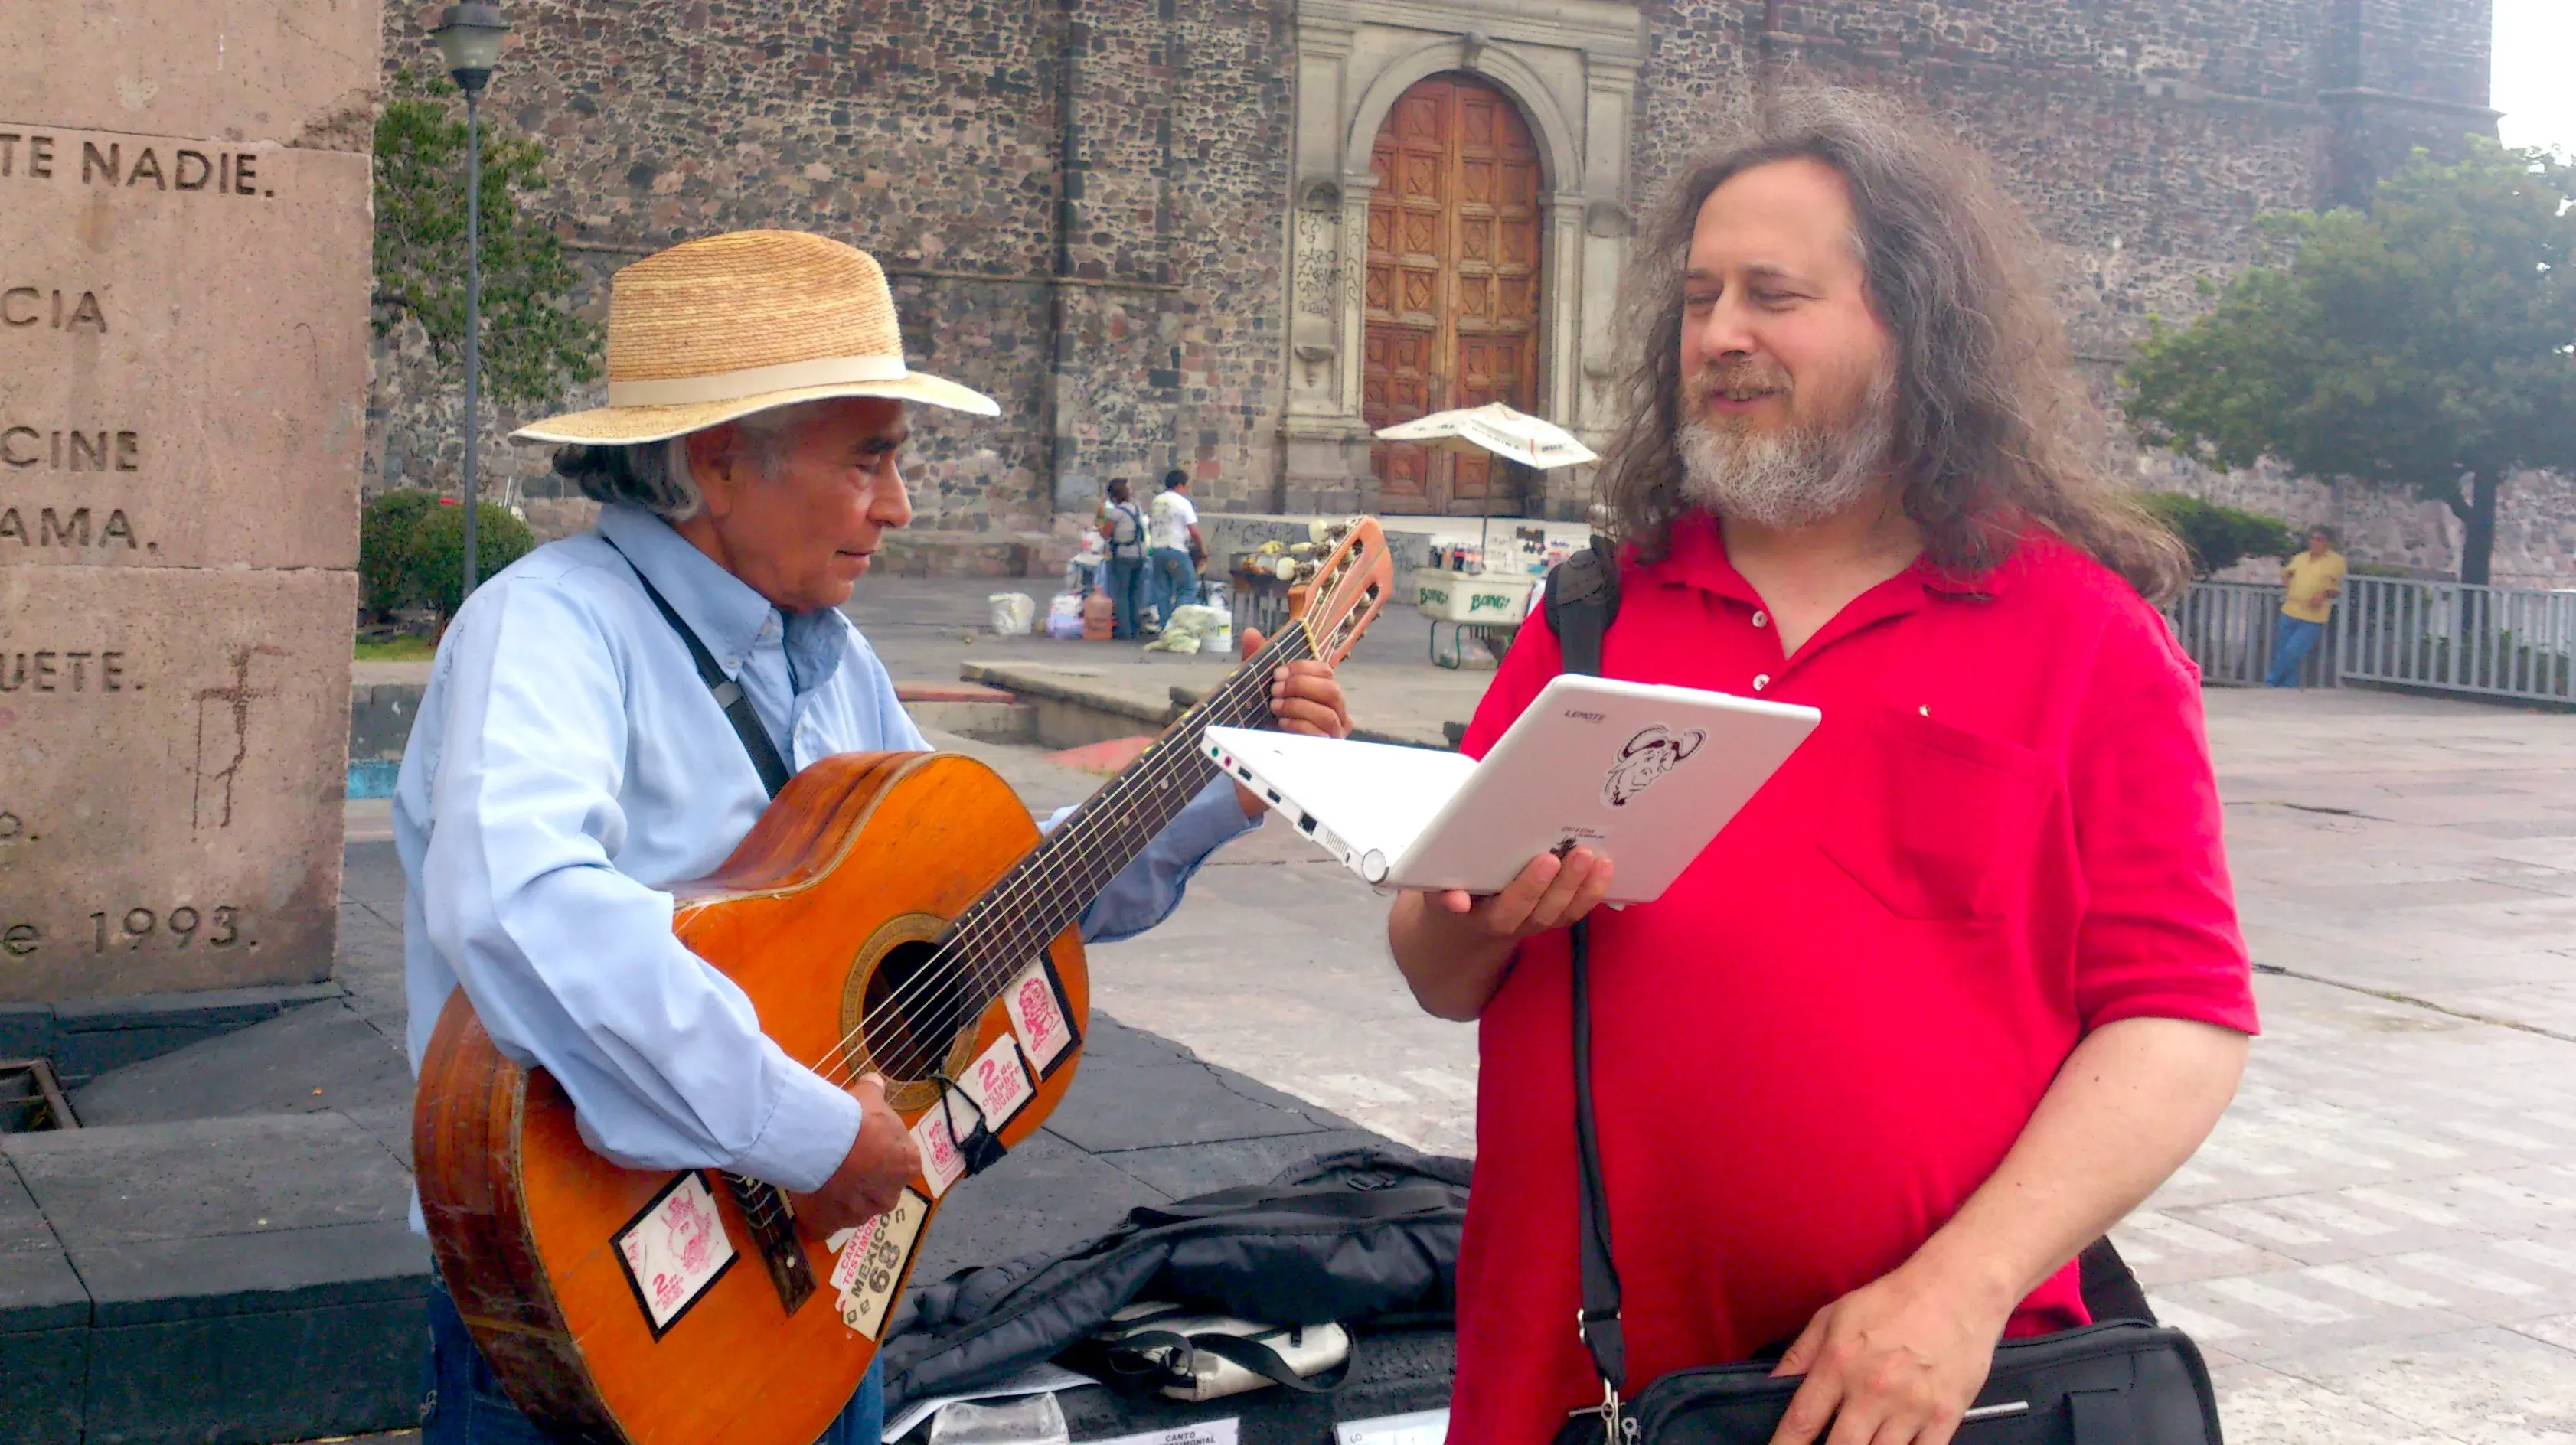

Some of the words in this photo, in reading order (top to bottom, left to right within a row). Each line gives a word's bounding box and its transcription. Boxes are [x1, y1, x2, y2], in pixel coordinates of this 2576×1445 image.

[82, 141, 274, 197] NADIE.
[1, 287, 107, 334] CIA
[0, 426, 138, 471] CINE
[0, 507, 158, 550] AMA.
[1469, 594, 1511, 612] BOING!
[0, 651, 145, 692] UETE.
[90, 906, 257, 954] 1993.
[978, 1058, 1000, 1093] 2
[1001, 1060, 1012, 1076] de
[851, 1212, 891, 1299] MEXICO
[868, 1240, 901, 1294] 68
[652, 1272, 669, 1298] 2
[1157, 1436, 1216, 1445] TIMONIAL
[1165, 1431, 1196, 1442] CANTO
